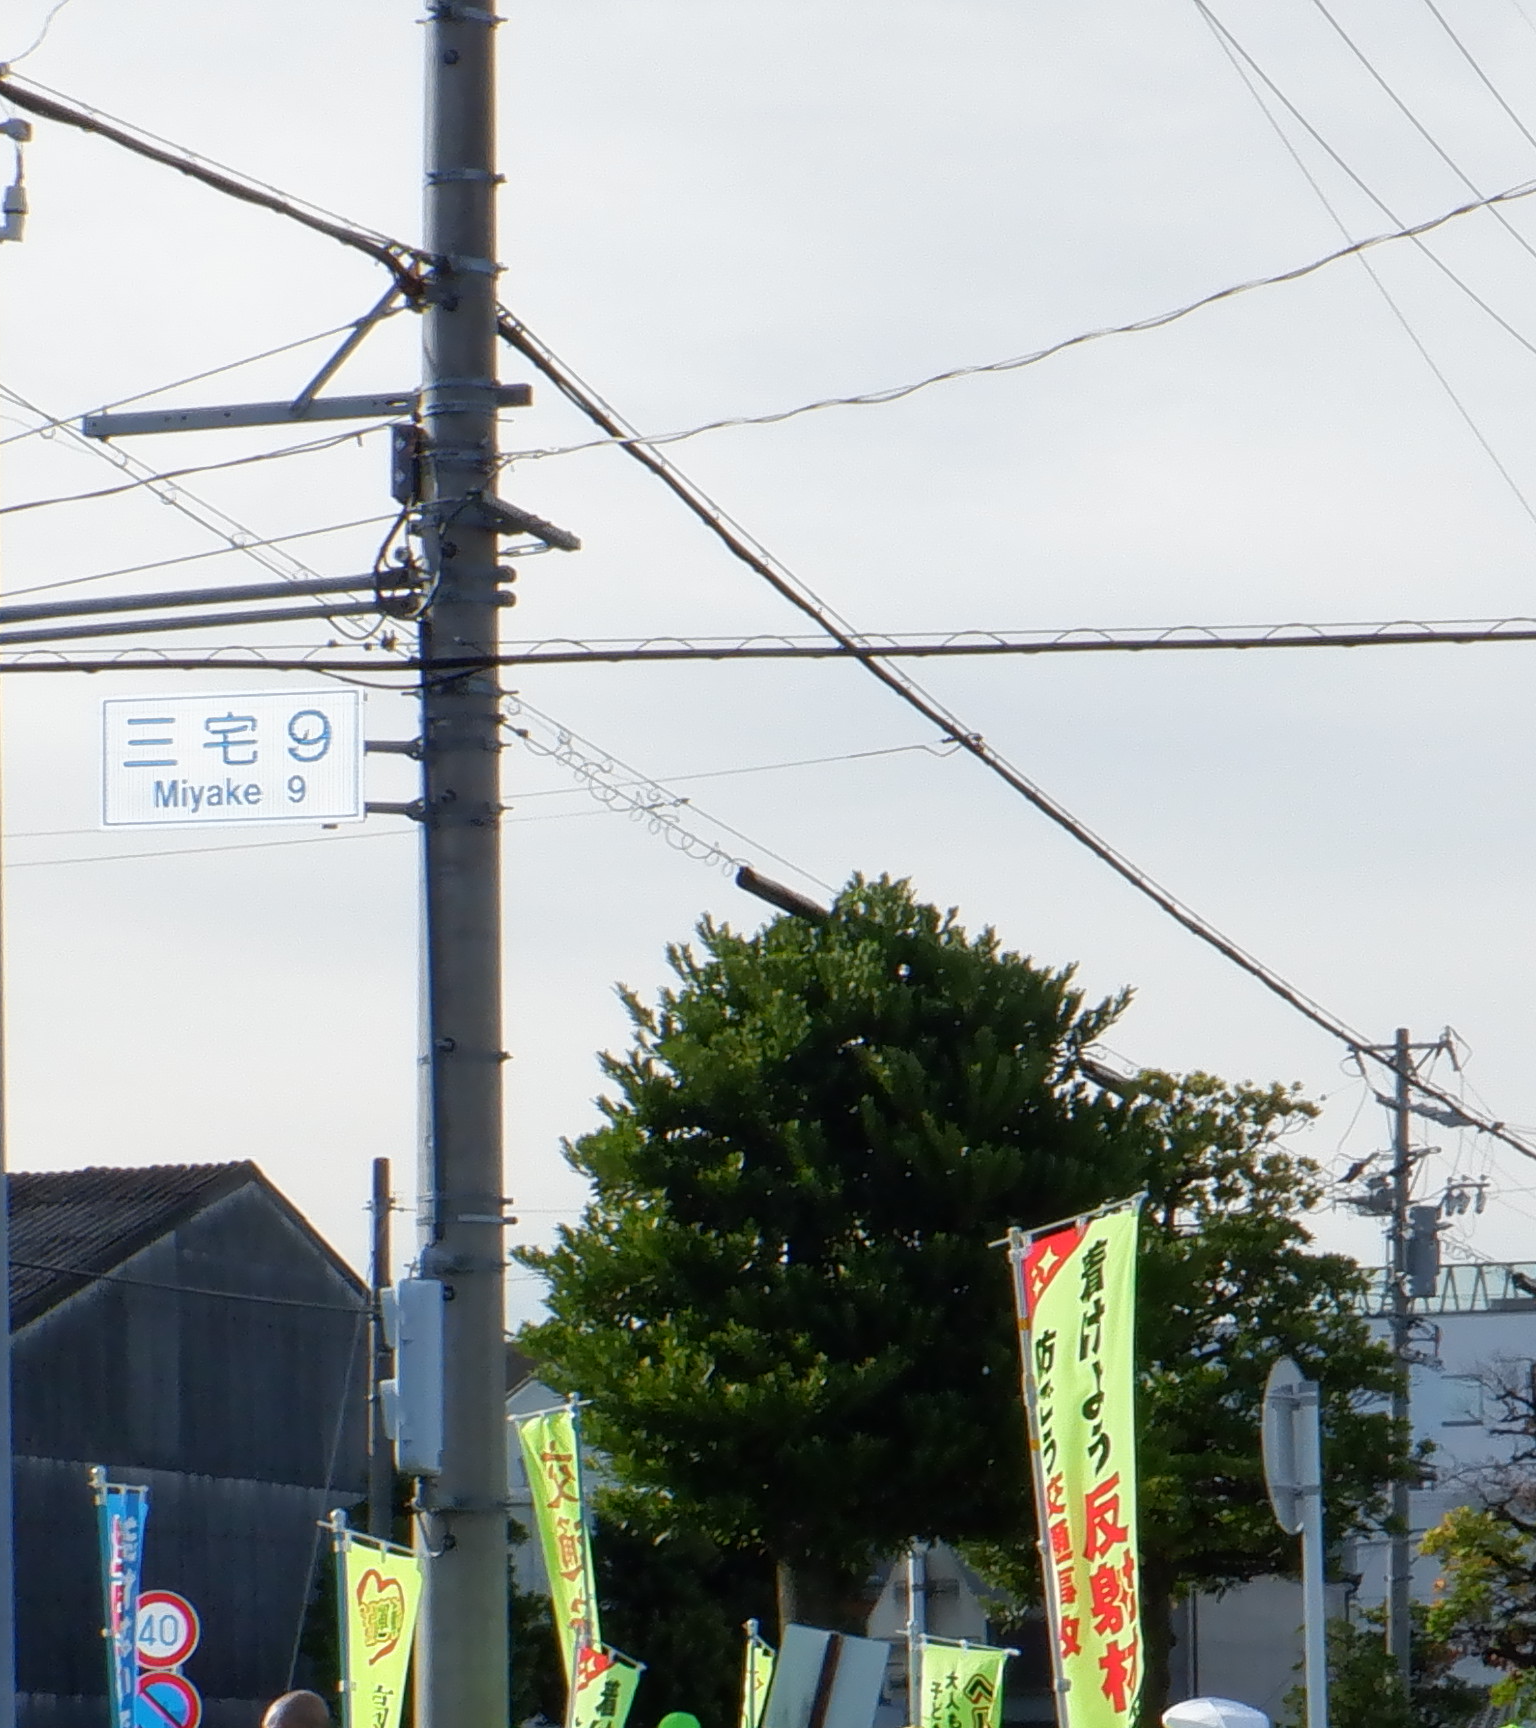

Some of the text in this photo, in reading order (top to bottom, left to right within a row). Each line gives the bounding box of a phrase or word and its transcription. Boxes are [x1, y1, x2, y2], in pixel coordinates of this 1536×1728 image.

[123, 709, 332, 768] 三宅9
[153, 775, 307, 812] Miyake 9
[138, 1613, 179, 1647] 40
